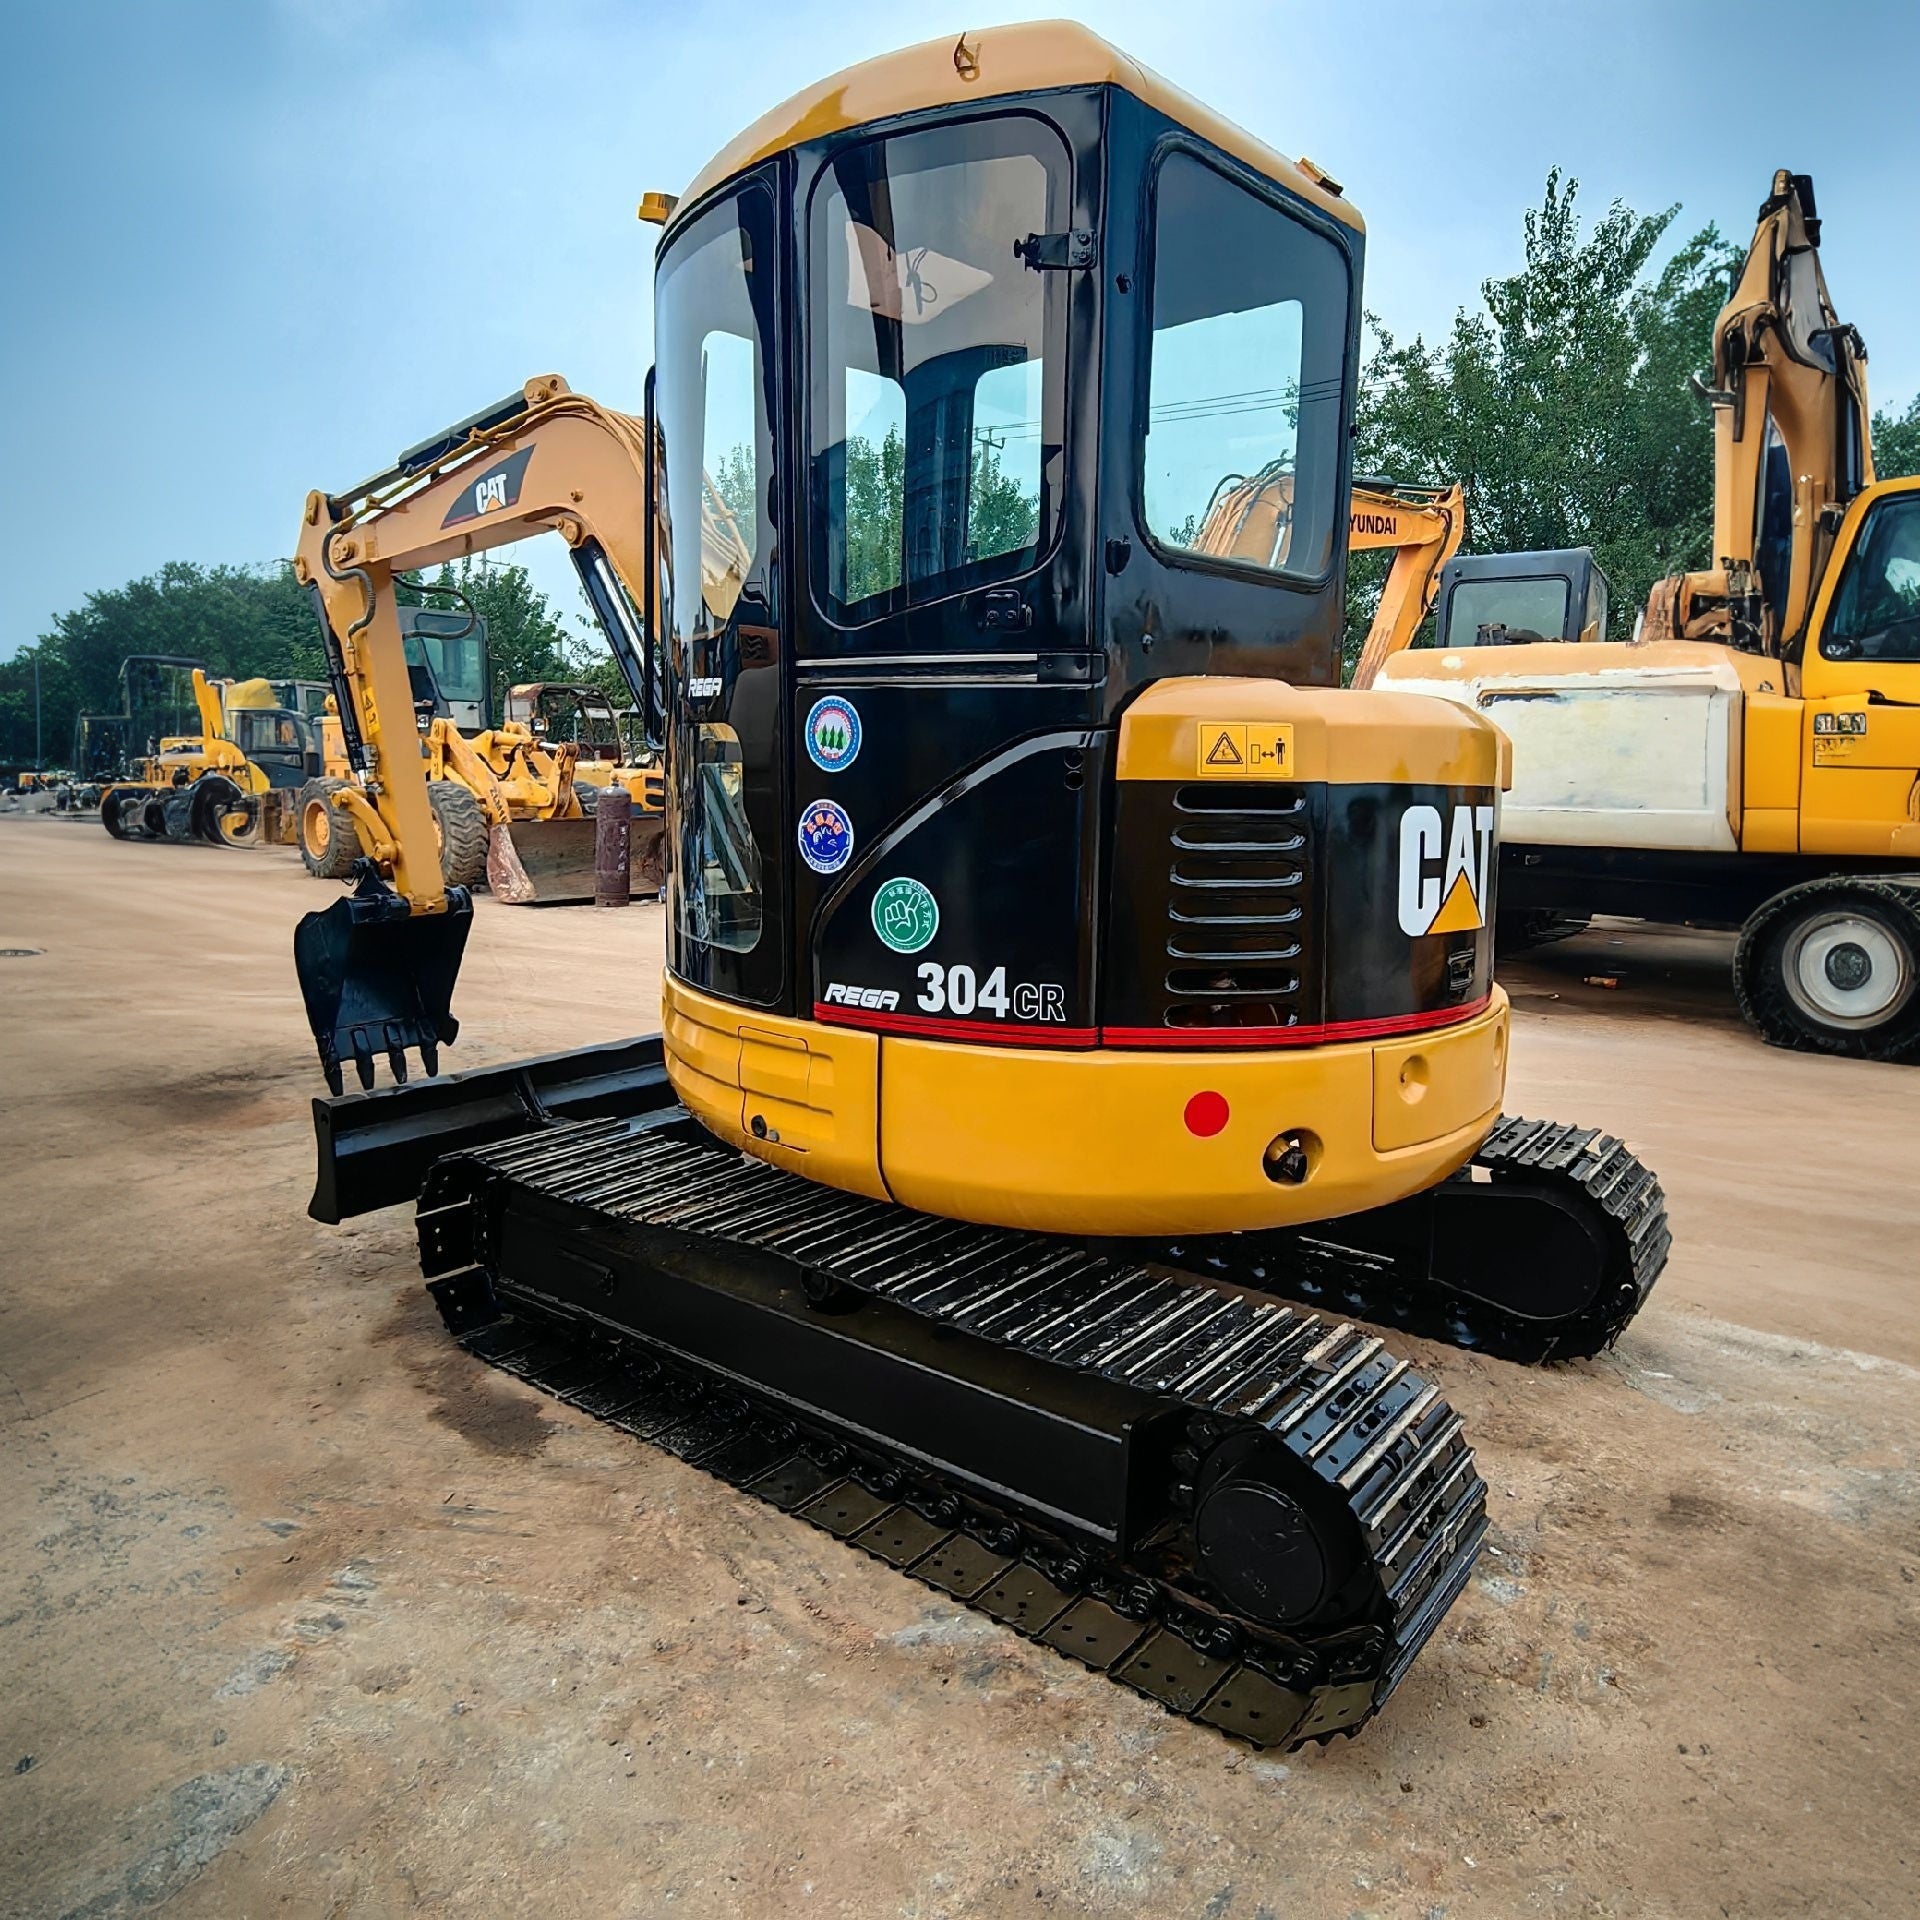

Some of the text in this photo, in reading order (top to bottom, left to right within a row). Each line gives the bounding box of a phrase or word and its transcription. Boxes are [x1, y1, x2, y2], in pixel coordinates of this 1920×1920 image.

[475, 473, 507, 514] CAT
[1350, 514, 1397, 535] YUNDAI
[688, 677, 723, 698] REGA
[1398, 805, 1494, 937] CAT
[824, 982, 900, 1012] REGA
